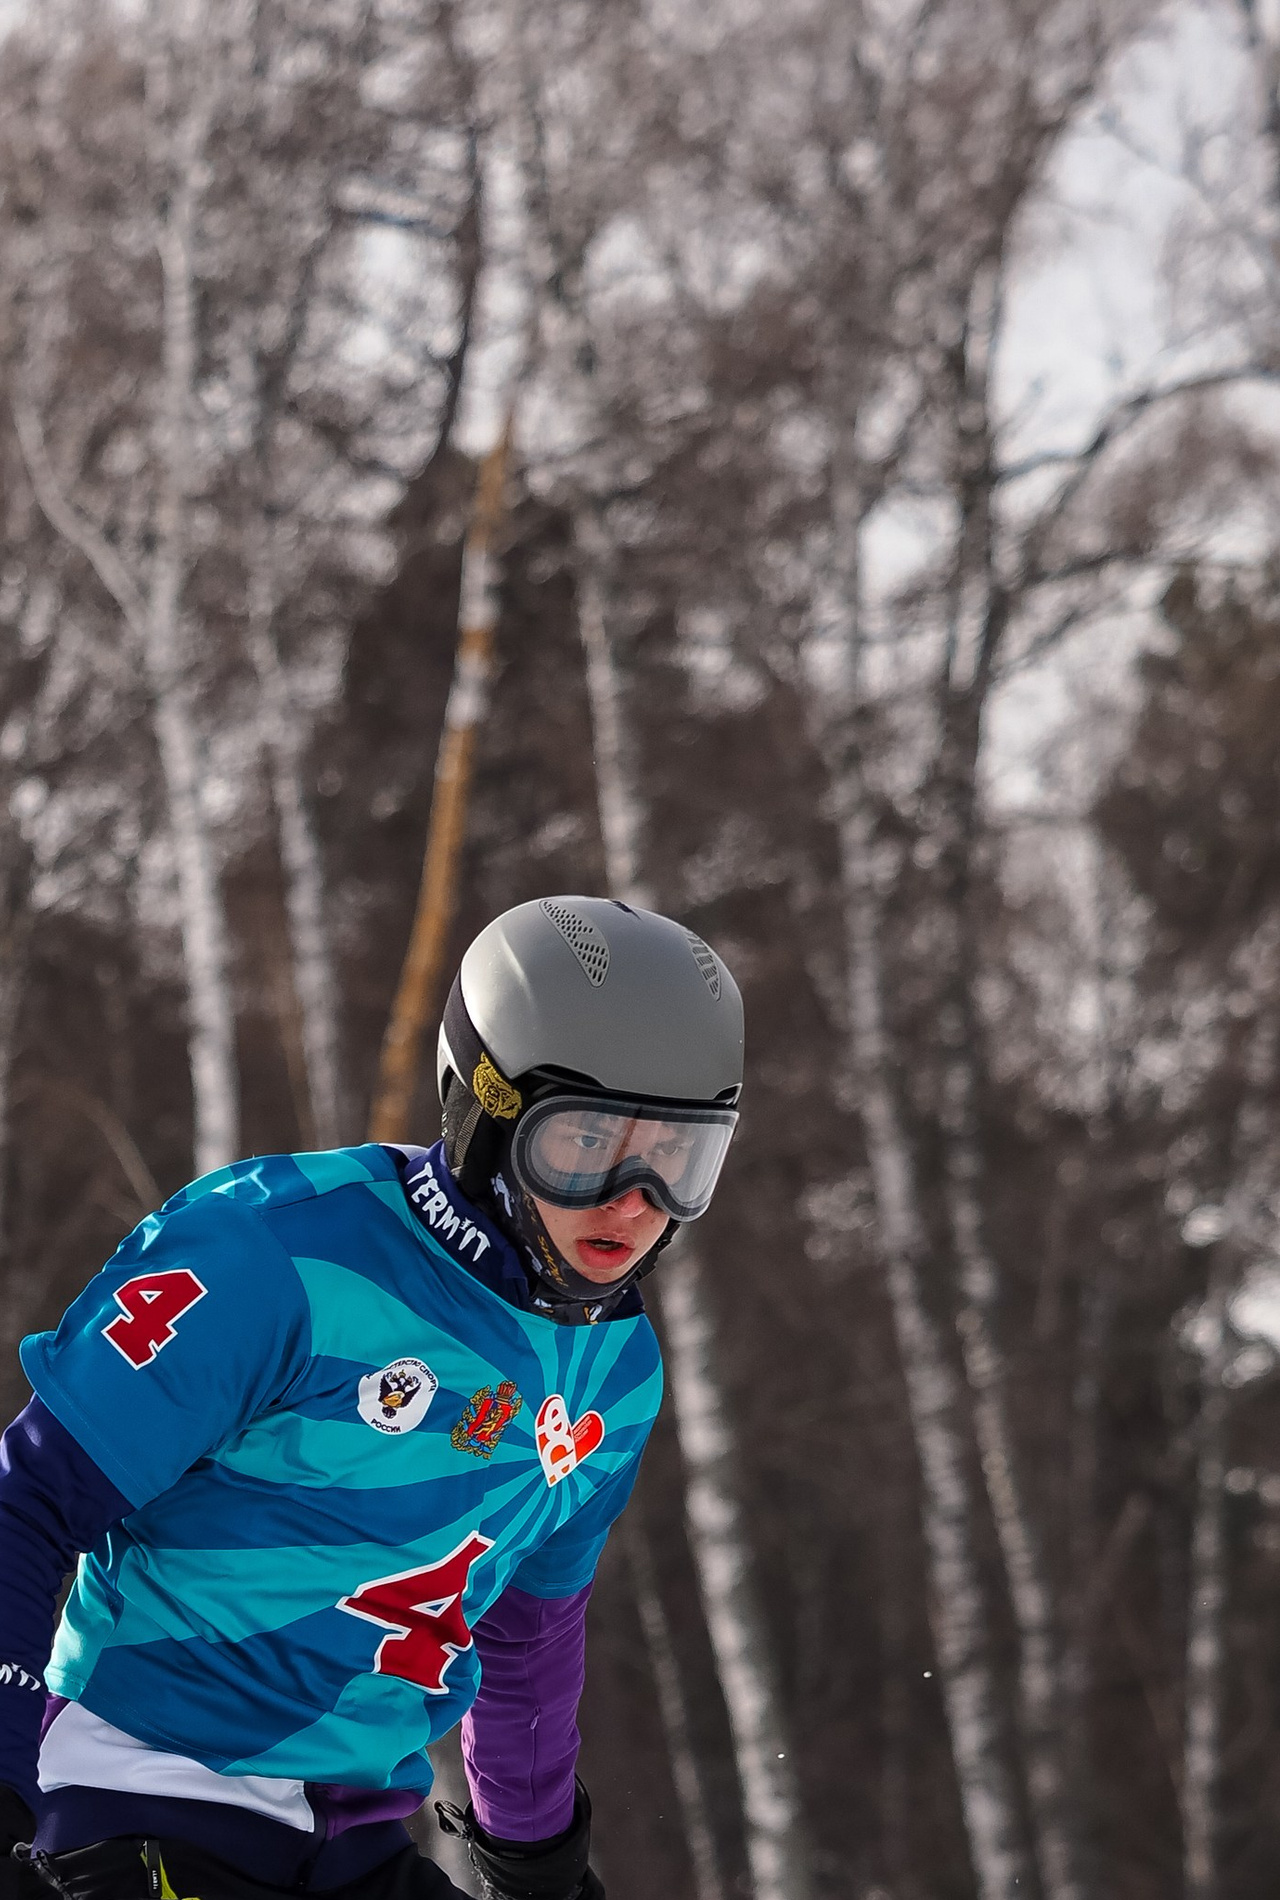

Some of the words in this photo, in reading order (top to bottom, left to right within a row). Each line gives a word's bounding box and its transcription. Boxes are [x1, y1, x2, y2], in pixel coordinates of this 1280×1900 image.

[101, 1269, 209, 1371] 4
[370, 1418, 402, 1433] РОССИИ
[335, 1530, 496, 1695] 4
